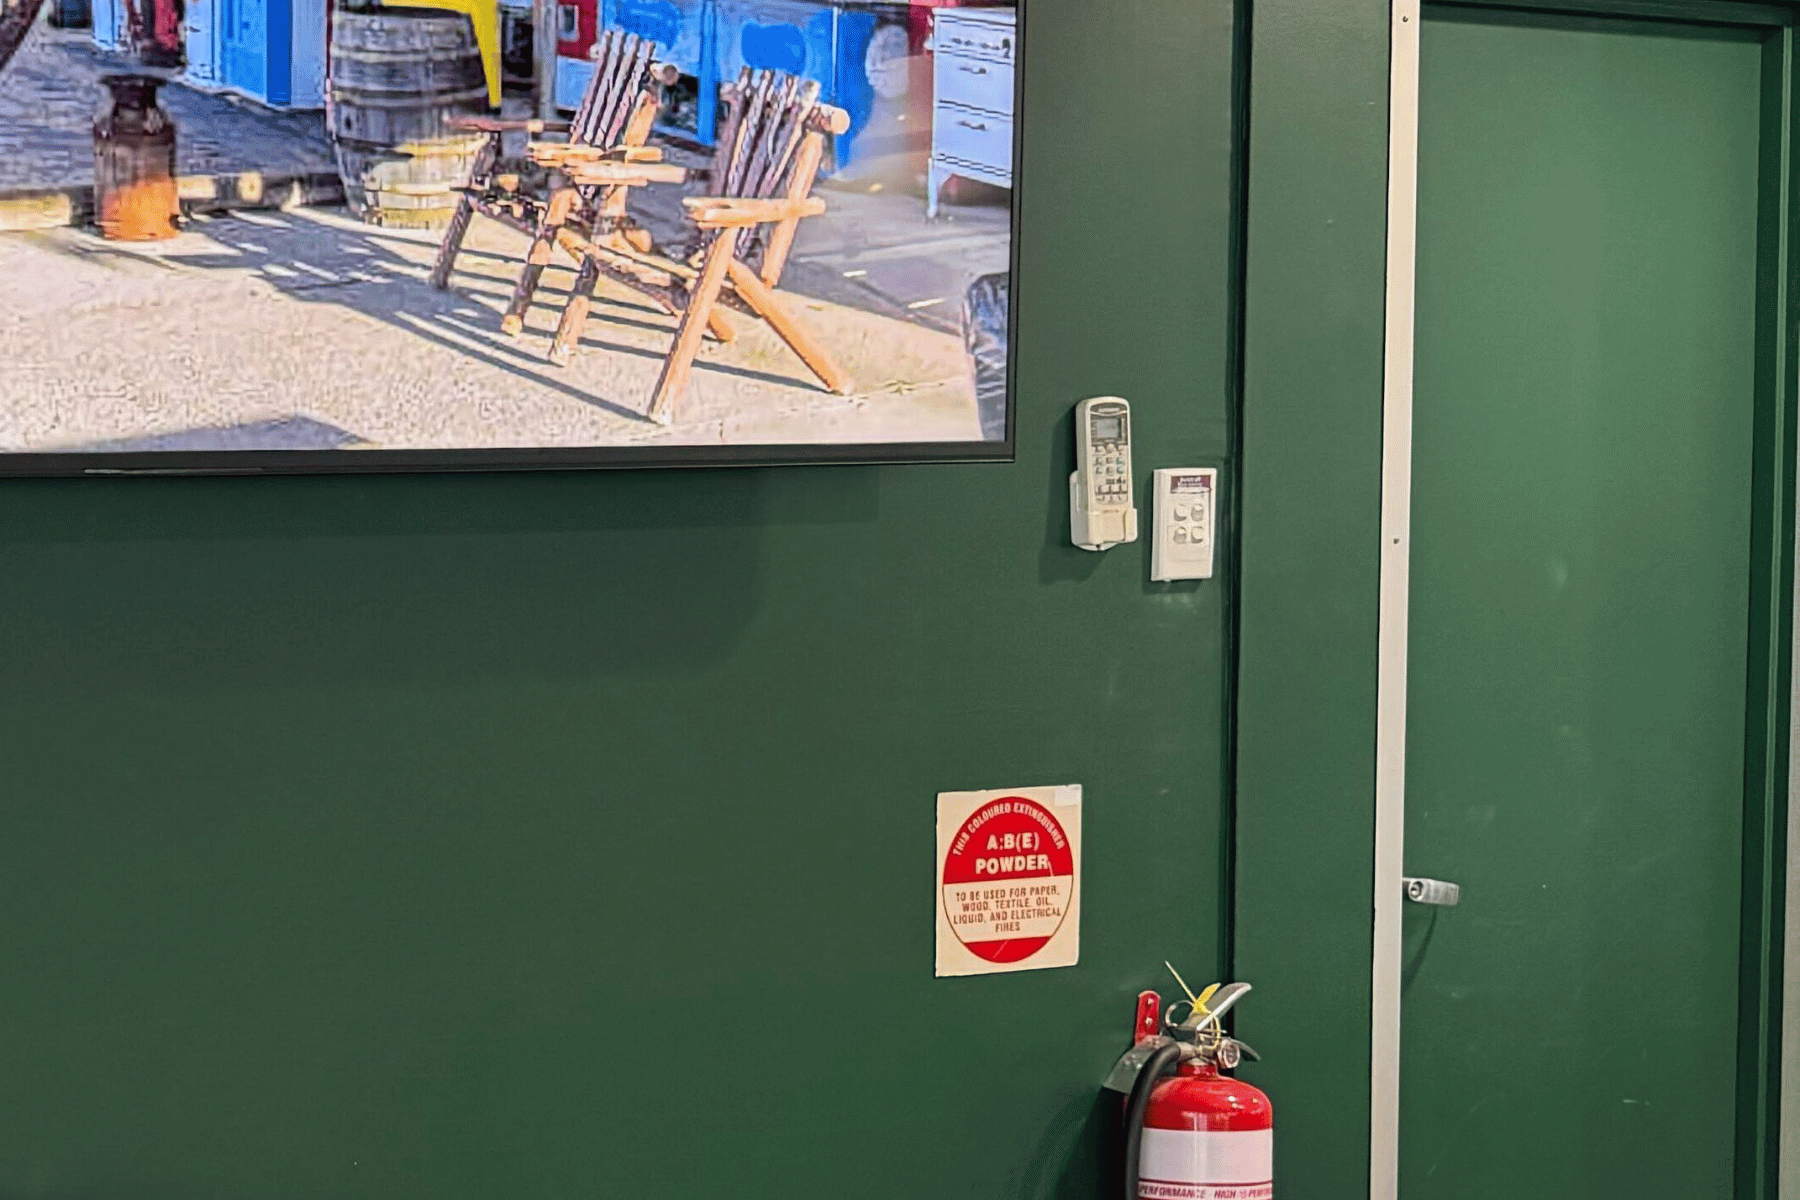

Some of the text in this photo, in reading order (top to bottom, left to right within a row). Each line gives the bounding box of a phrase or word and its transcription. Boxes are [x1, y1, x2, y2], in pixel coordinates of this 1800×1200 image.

[967, 802, 1011, 833] COLOURED
[975, 854, 1049, 875] POWDER
[955, 892, 967, 902] TO
[969, 890, 980, 901] BE
[983, 888, 1006, 900] USED
[1009, 887, 1027, 898] FOR
[989, 910, 1008, 922] AND
[1010, 907, 1062, 920] ELECTRICAL
[995, 921, 1021, 933] FIRES
